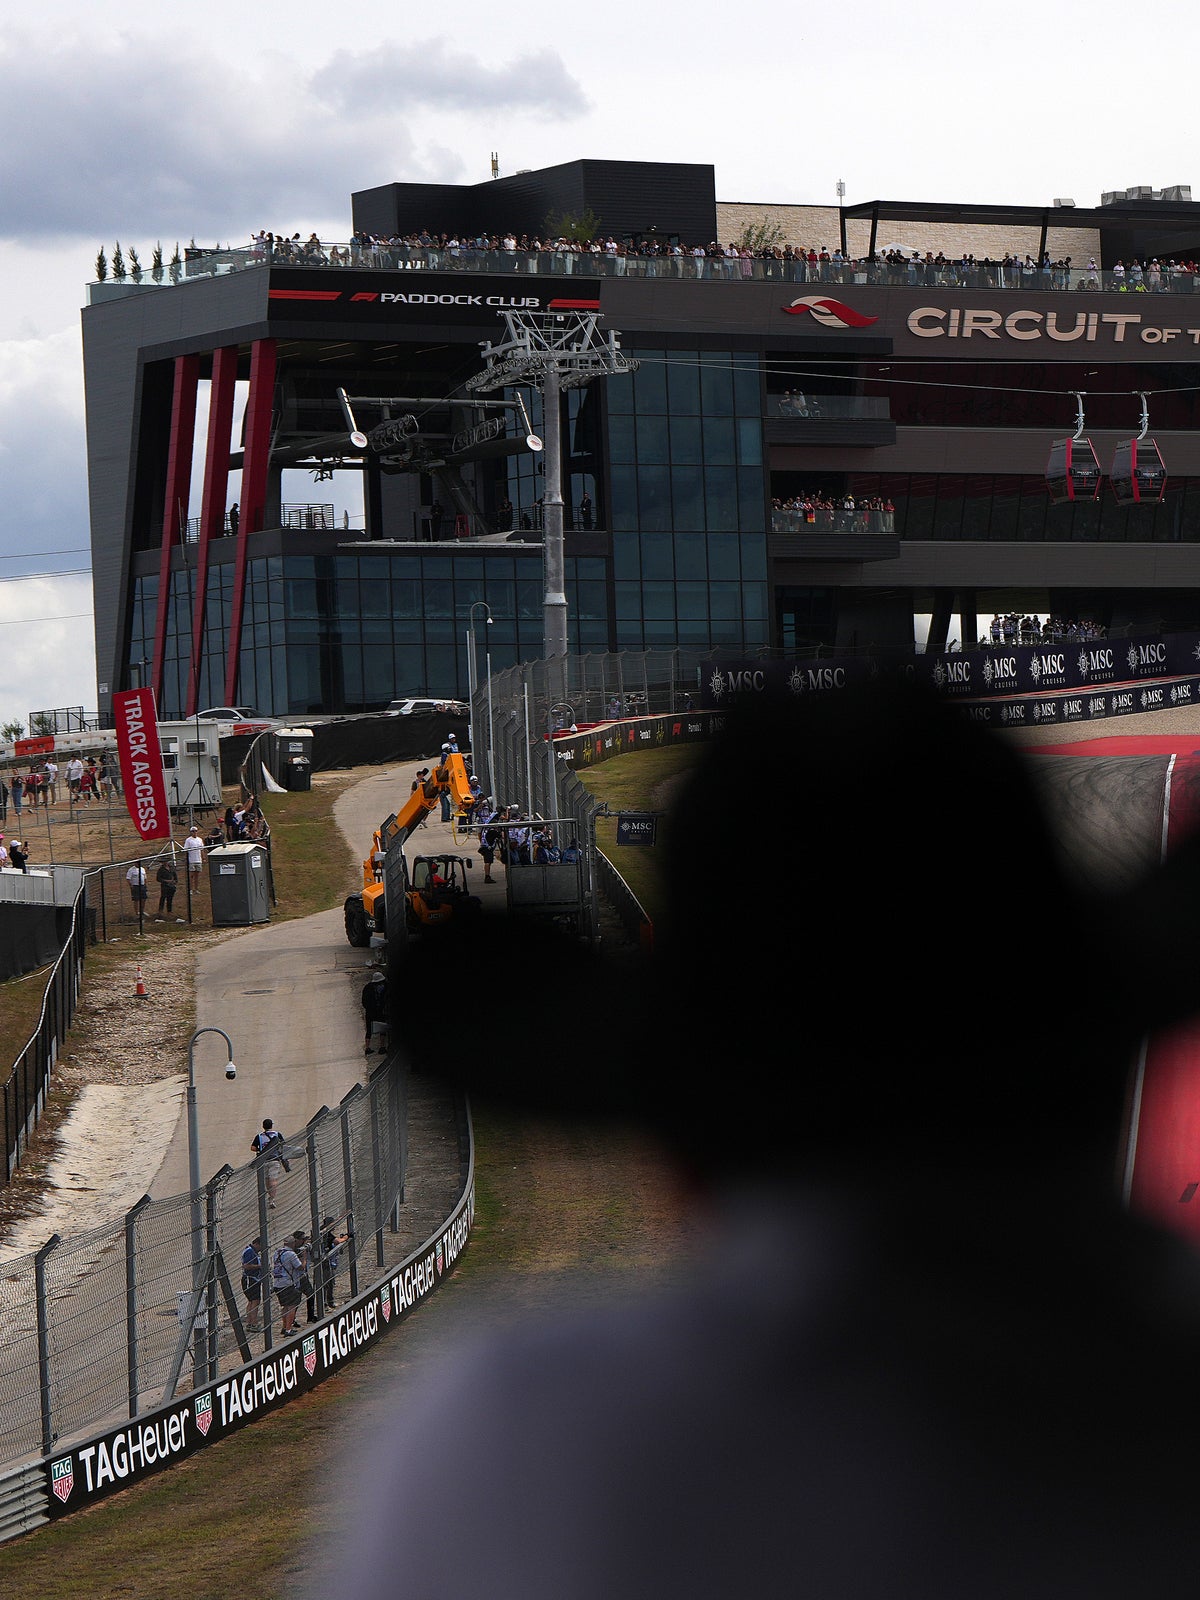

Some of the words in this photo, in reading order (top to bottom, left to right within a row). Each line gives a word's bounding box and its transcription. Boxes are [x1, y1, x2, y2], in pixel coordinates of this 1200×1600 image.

[380, 293, 482, 305] PADDOCK
[486, 296, 540, 307] CLUB
[907, 307, 1141, 342] CIRCUIT
[1140, 328, 1181, 343] OF
[1090, 649, 1114, 671] MSC
[1139, 643, 1167, 665] MSC
[946, 661, 970, 683] MSC
[994, 657, 1017, 678] MSC
[1041, 653, 1065, 674] MSC
[1140, 665, 1167, 675] CRUISES
[728, 670, 765, 692] MSC
[808, 667, 846, 690] MSC
[995, 681, 1018, 689] CRUISES
[1042, 676, 1066, 685] CRUISES
[1090, 671, 1115, 681] CRUISES
[1118, 693, 1133, 707] MSC
[1147, 689, 1163, 703] MSC
[1177, 684, 1191, 698] MSC
[1009, 705, 1025, 719] MSC
[1041, 702, 1056, 716] MSC
[1069, 700, 1082, 713] MSC
[1094, 697, 1105, 711] MSC
[969, 707, 991, 721] MSC
[124, 695, 147, 758] TRACK
[131, 761, 158, 832] ACCESS
[631, 822, 652, 830] MSC
[391, 1251, 436, 1315] TAGHeuer
[318, 1297, 379, 1368] TAGHeuer
[303, 1338, 315, 1356] TAG
[216, 1348, 299, 1426] TAGHeuer
[196, 1395, 211, 1413] TAG
[79, 1408, 189, 1492] TAGHeuer
[53, 1460, 71, 1478] TAG
